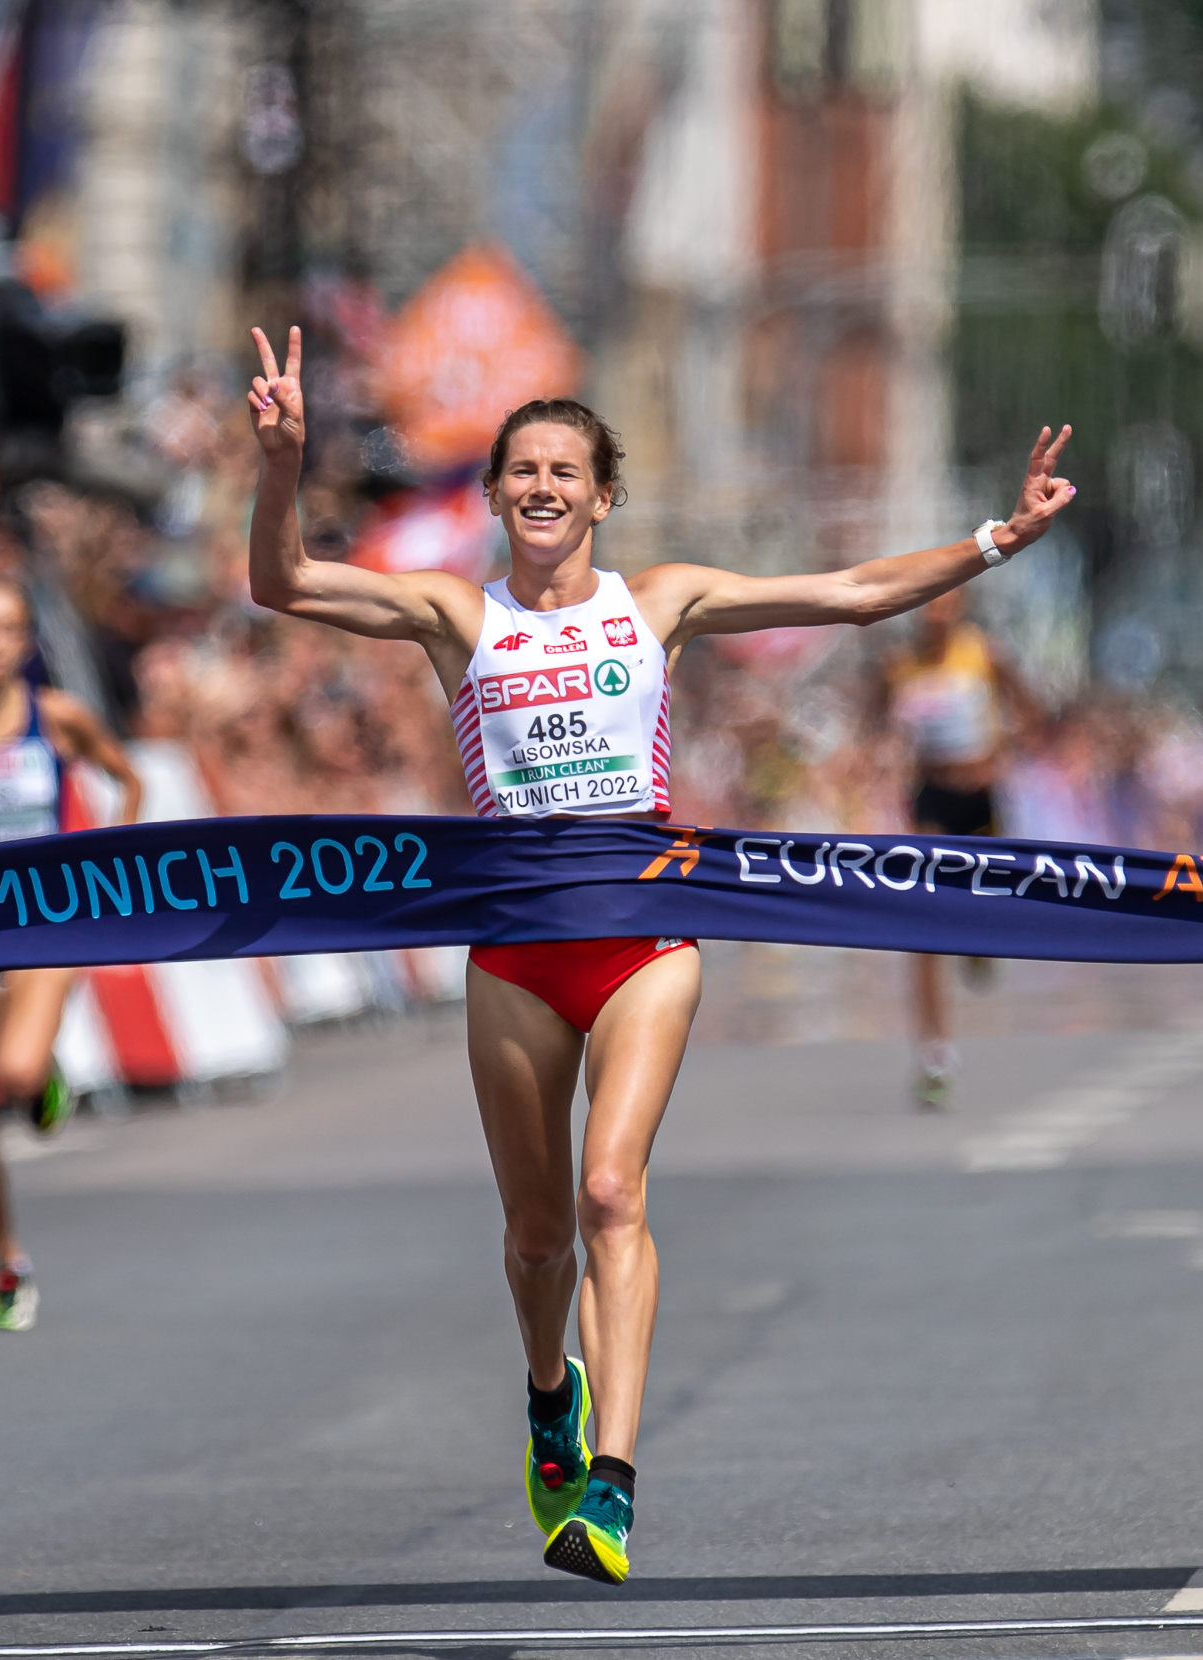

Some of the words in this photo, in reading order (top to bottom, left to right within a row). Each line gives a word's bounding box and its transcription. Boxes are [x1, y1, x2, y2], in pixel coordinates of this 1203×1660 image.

[545, 641, 586, 654] ORLEN
[481, 668, 589, 709] SPAR
[527, 710, 588, 743] 485
[512, 737, 611, 765] LISOWSKA
[528, 765, 556, 781] RUN
[498, 781, 580, 808] MUNICH
[587, 775, 640, 798] 2022
[270, 832, 433, 900] 2022
[734, 836, 1128, 900] EUROPEAN
